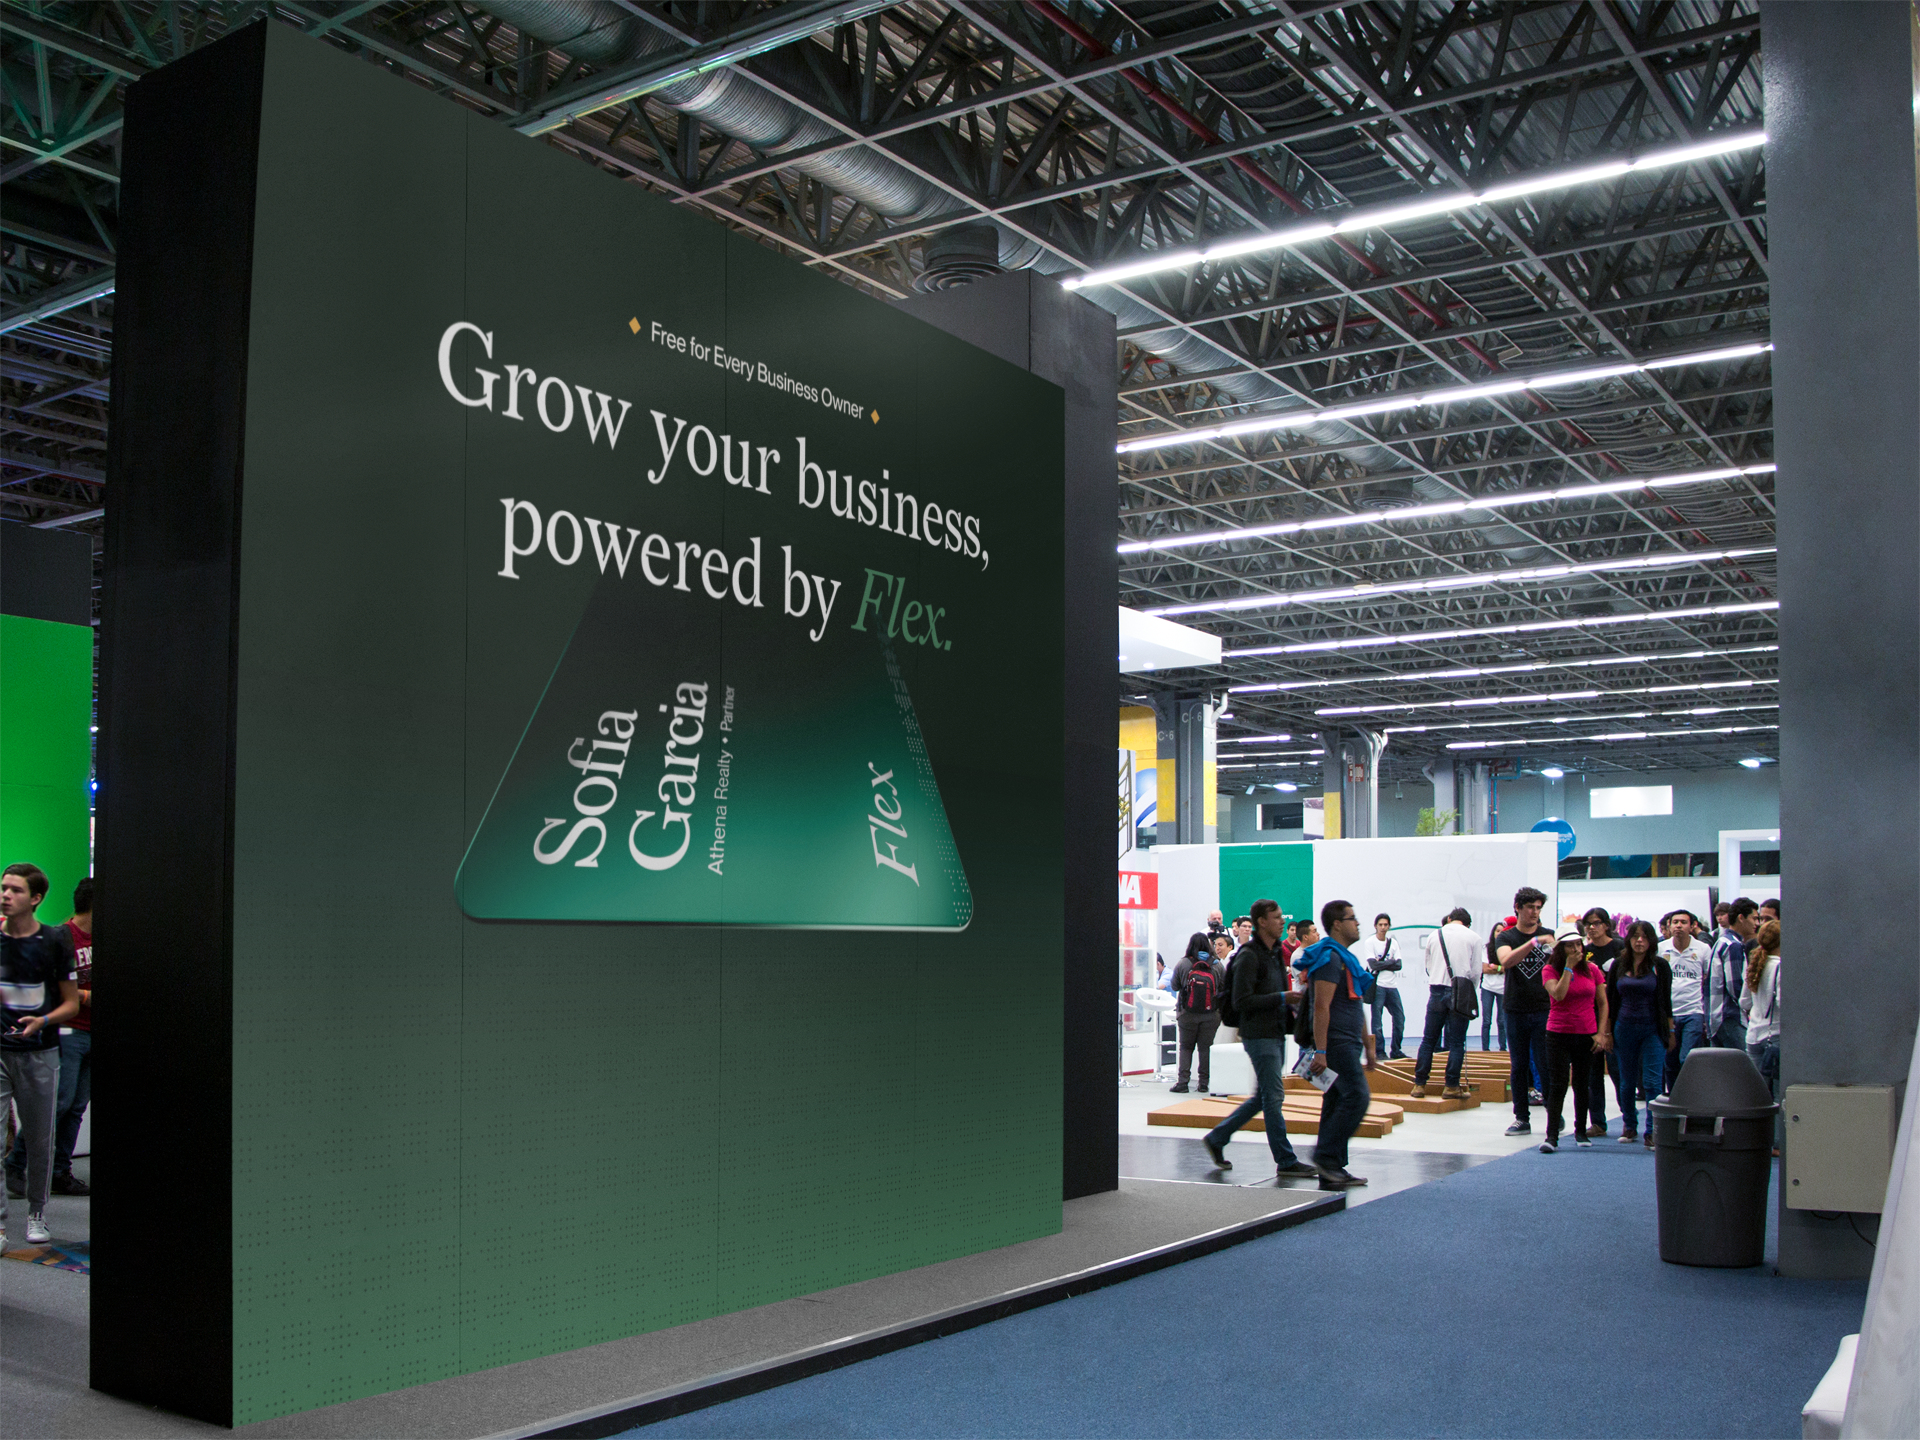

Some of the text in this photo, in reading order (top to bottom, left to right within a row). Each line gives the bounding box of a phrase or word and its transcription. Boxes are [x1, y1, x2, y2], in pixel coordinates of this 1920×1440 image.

[438, 321, 989, 571] Grow your business,
[651, 320, 865, 420] Free for Every Business Owner
[498, 497, 953, 651] powered by Flex.
[533, 709, 638, 867] Sofia
[628, 681, 708, 871] Garcia
[707, 685, 735, 876] Athena Realty Partner
[867, 761, 920, 887] Flex
